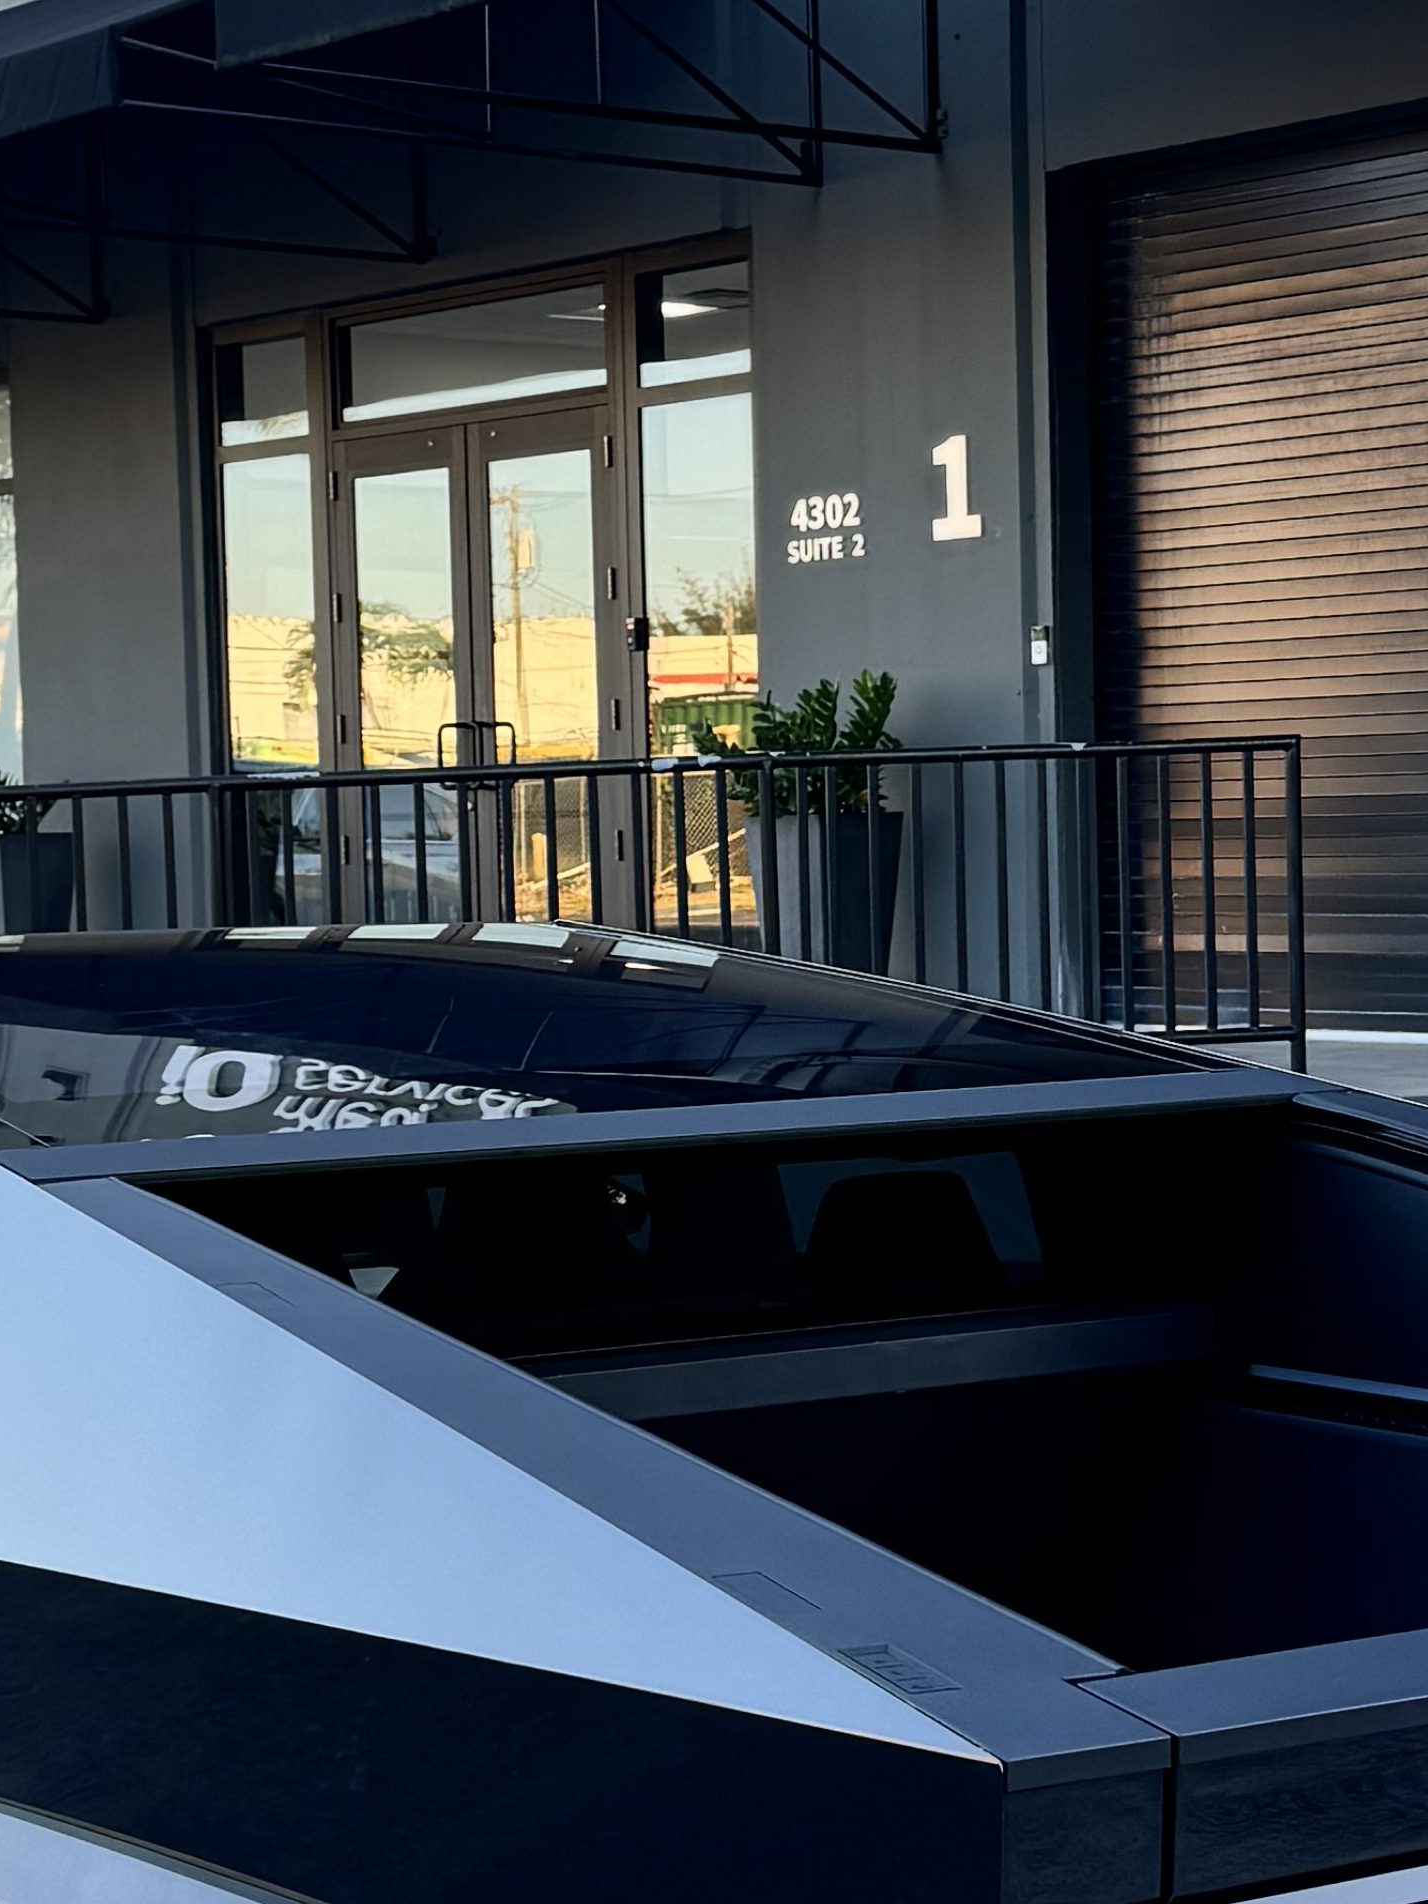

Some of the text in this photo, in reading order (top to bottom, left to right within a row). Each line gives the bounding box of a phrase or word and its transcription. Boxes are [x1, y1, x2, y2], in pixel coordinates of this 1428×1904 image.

[931, 434, 983, 542] 1
[789, 492, 862, 533] 4302
[786, 533, 867, 565] SUITE 2
